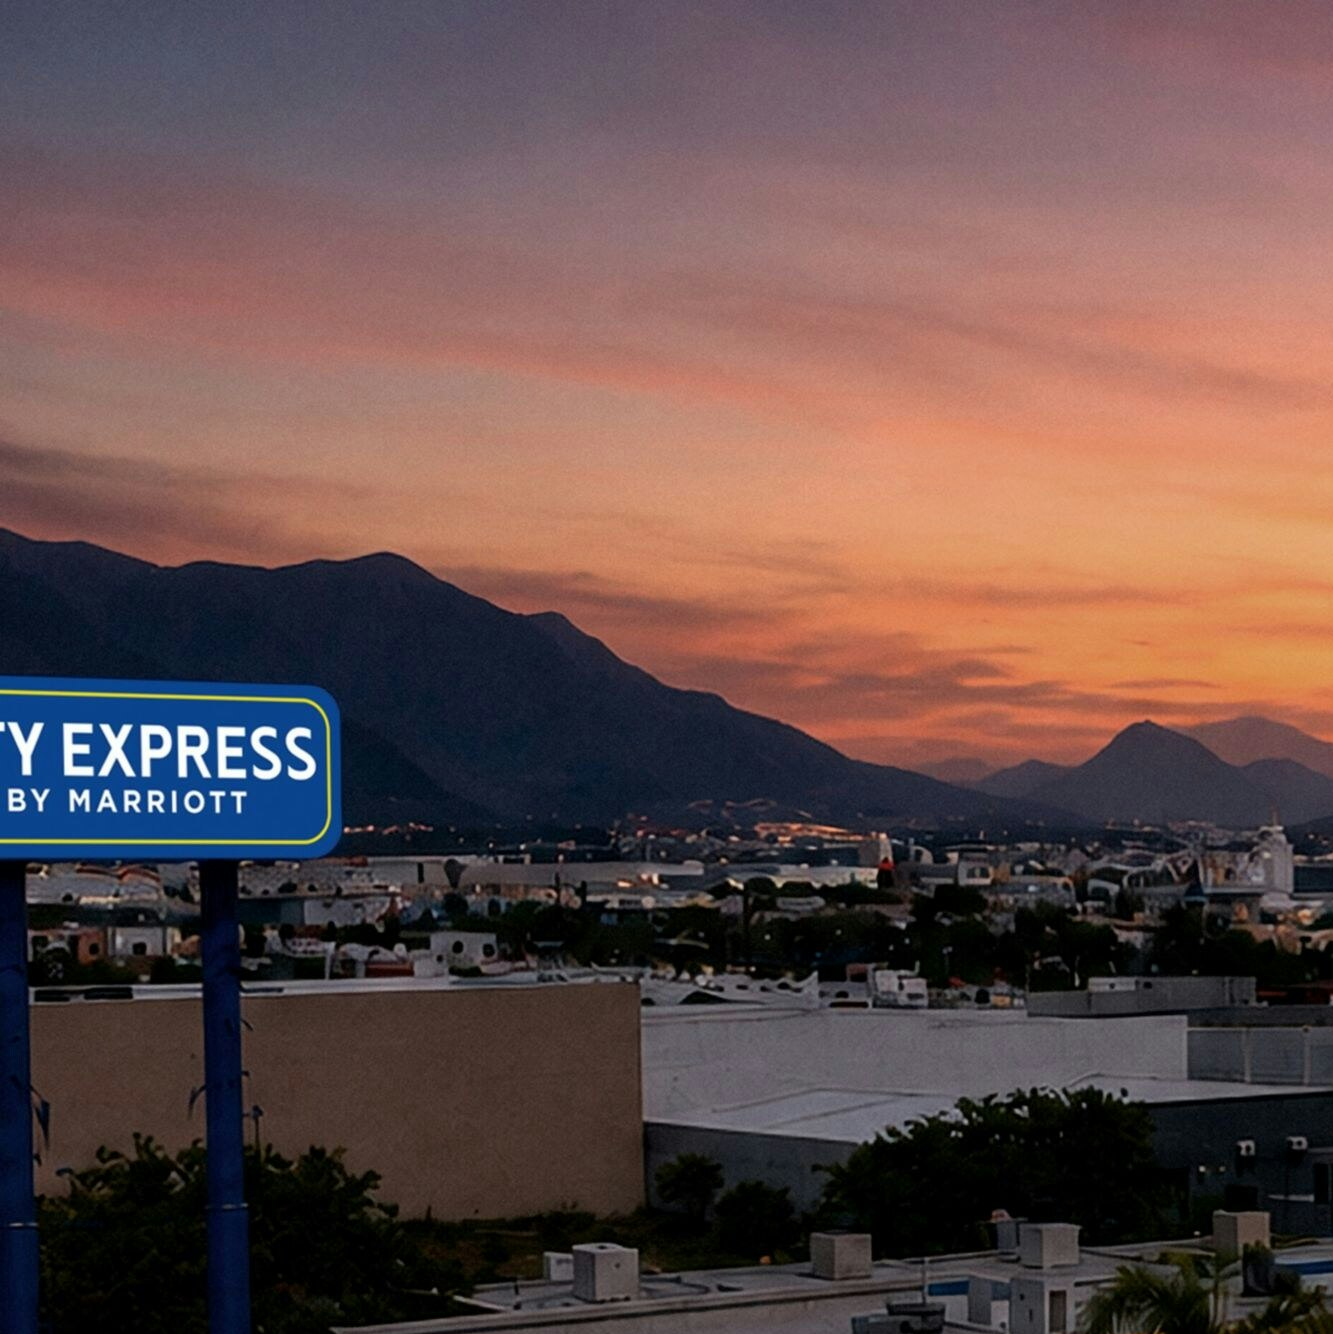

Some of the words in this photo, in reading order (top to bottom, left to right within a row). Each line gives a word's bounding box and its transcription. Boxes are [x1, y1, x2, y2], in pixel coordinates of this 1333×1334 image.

[0, 721, 44, 776] Y
[62, 722, 317, 781] EXPRESS
[7, 788, 50, 812] BY
[69, 788, 248, 814] MARRIOTT
